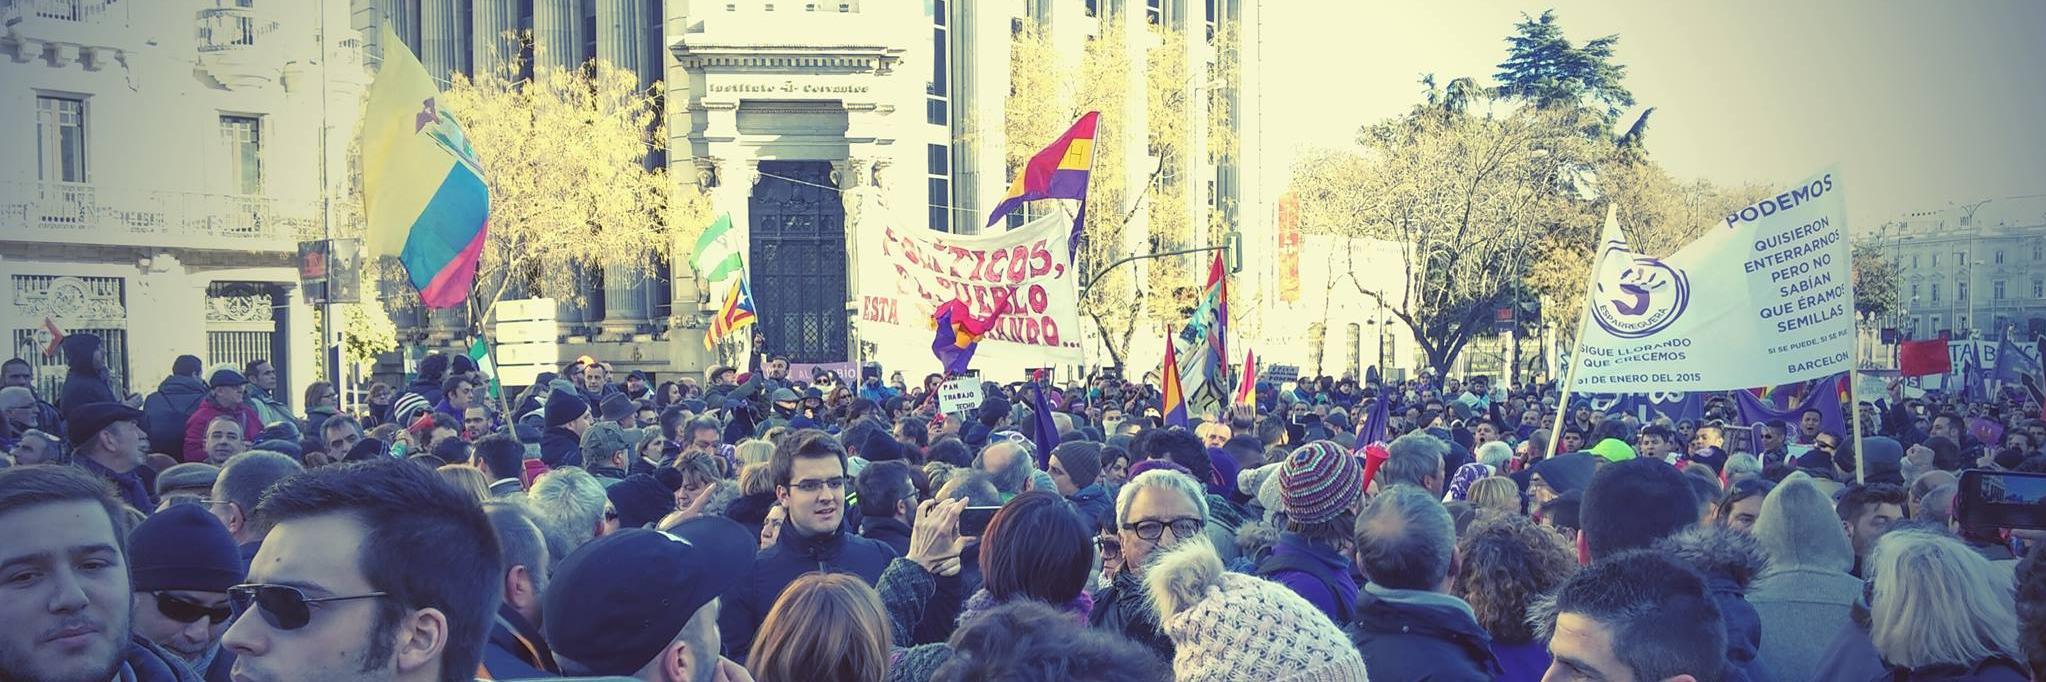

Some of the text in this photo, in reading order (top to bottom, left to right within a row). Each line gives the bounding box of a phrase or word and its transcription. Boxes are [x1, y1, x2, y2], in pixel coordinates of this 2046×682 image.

[1726, 173, 1832, 229] PODEMOS
[1754, 216, 1830, 252] QUISIERON
[1744, 228, 1840, 273] ENTERRARNOS
[1771, 253, 1832, 283] PERO NO
[1780, 271, 1832, 298] SABÍAN
[862, 295, 900, 326] ESTA
[1599, 304, 1669, 330] ESPARREGUERA
[1760, 302, 1794, 319] QUE
[1777, 304, 1844, 333] SEMILLAS
[1580, 338, 1692, 357] SIGUE LLORANDO
[1584, 358, 1611, 369] QUE
[1615, 352, 1687, 365] CRECEMOS
[1787, 350, 1849, 374] BARCELON
[943, 383, 959, 391] PAN
[1591, 375, 1608, 385] DE
[1610, 374, 1649, 384] ENERO
[1651, 373, 1673, 383] DEL
[1676, 372, 1702, 383] 2015
[943, 391, 975, 401] TRABAJO
[956, 402, 976, 410] TECHO
